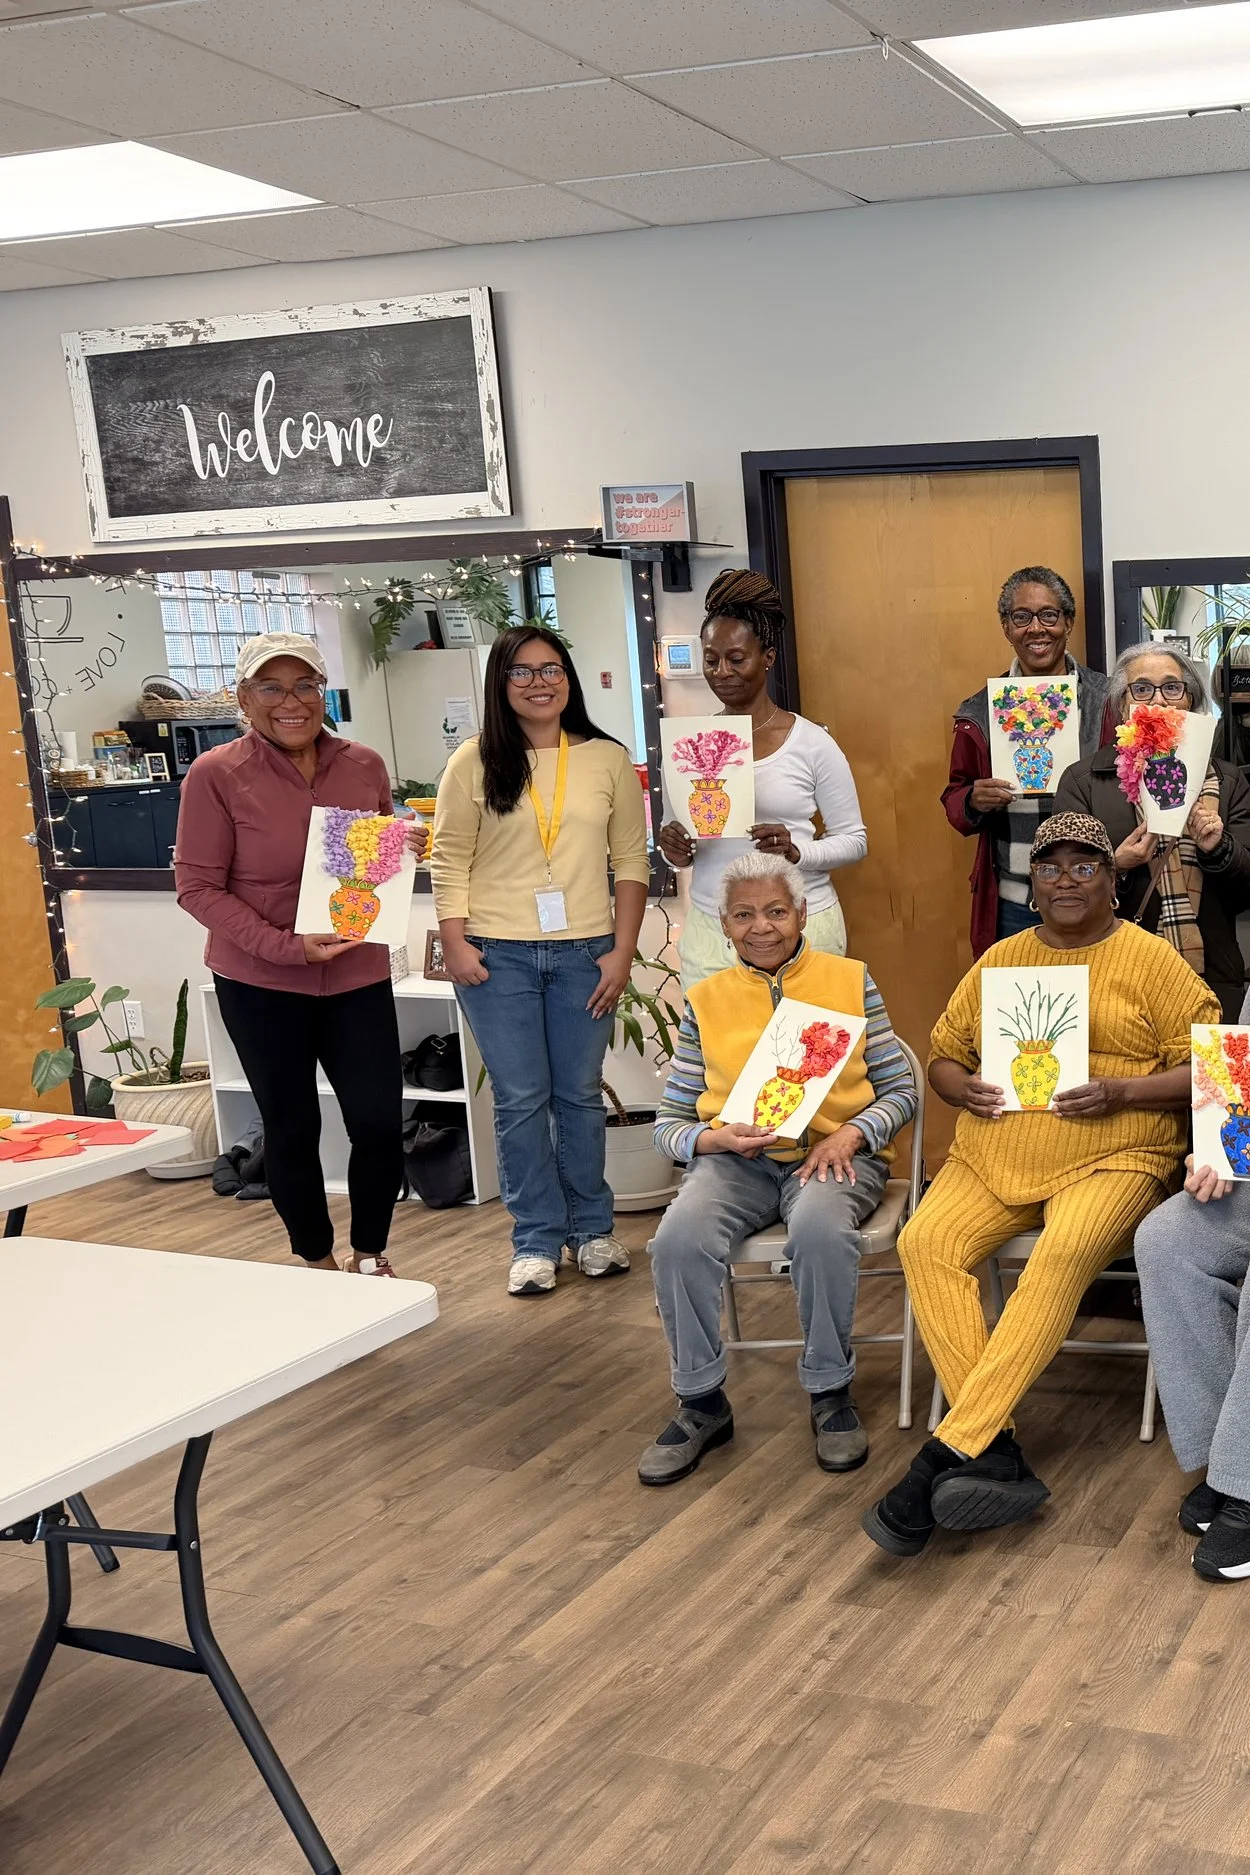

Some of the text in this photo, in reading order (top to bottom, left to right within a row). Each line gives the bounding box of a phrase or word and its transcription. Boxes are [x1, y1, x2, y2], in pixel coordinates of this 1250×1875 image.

[176, 370, 394, 480] Welcome
[612, 492, 659, 504] we are
[614, 520, 674, 536] together
